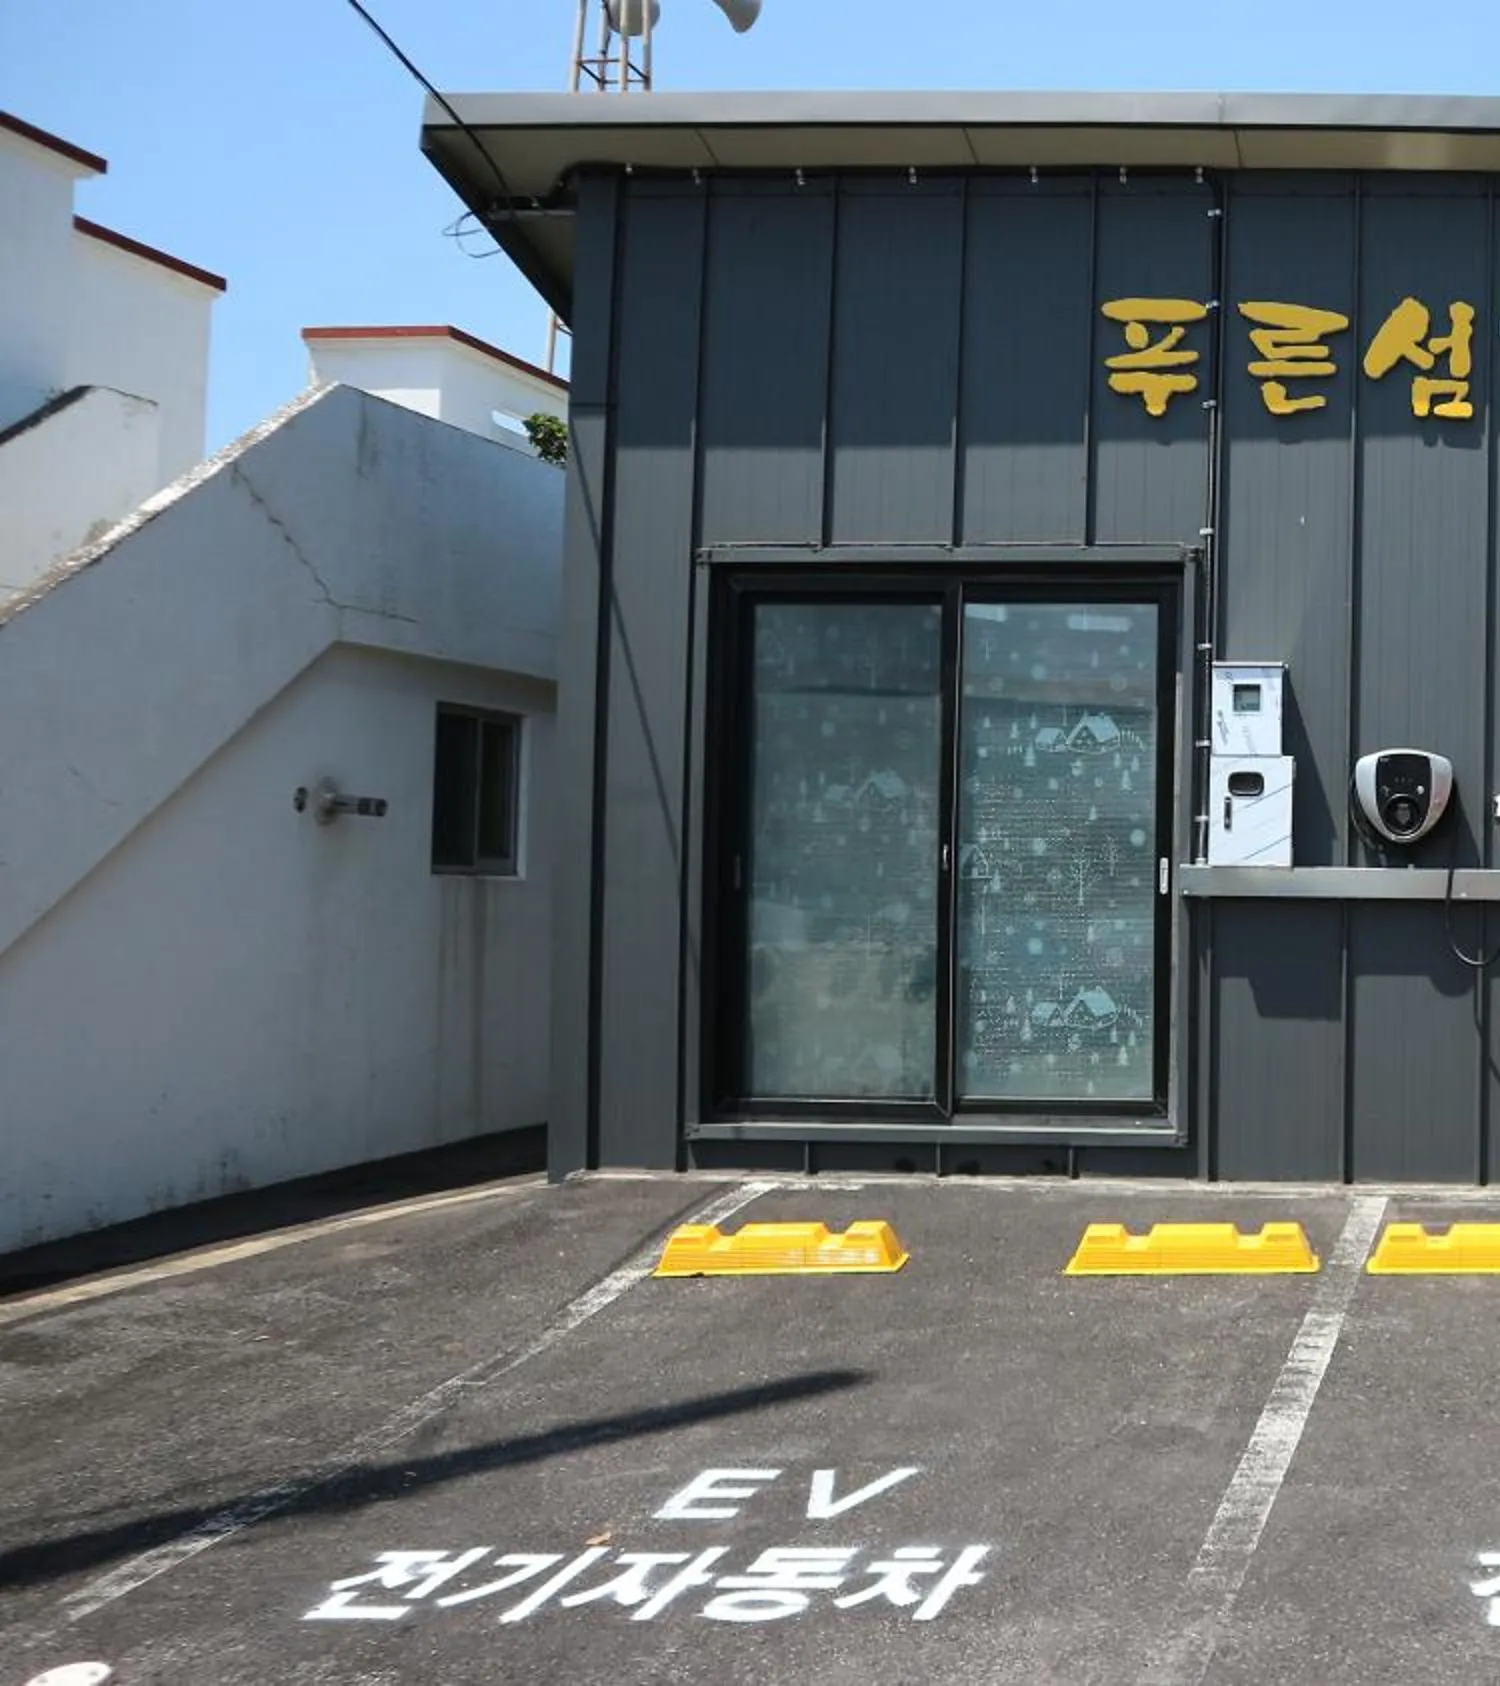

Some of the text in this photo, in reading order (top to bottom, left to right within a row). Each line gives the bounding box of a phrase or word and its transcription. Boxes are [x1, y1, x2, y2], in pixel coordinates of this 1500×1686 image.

[1101, 297, 1473, 417] 푸른섬
[651, 1467, 919, 1520] EV
[302, 1543, 992, 1624] 전기자동차
